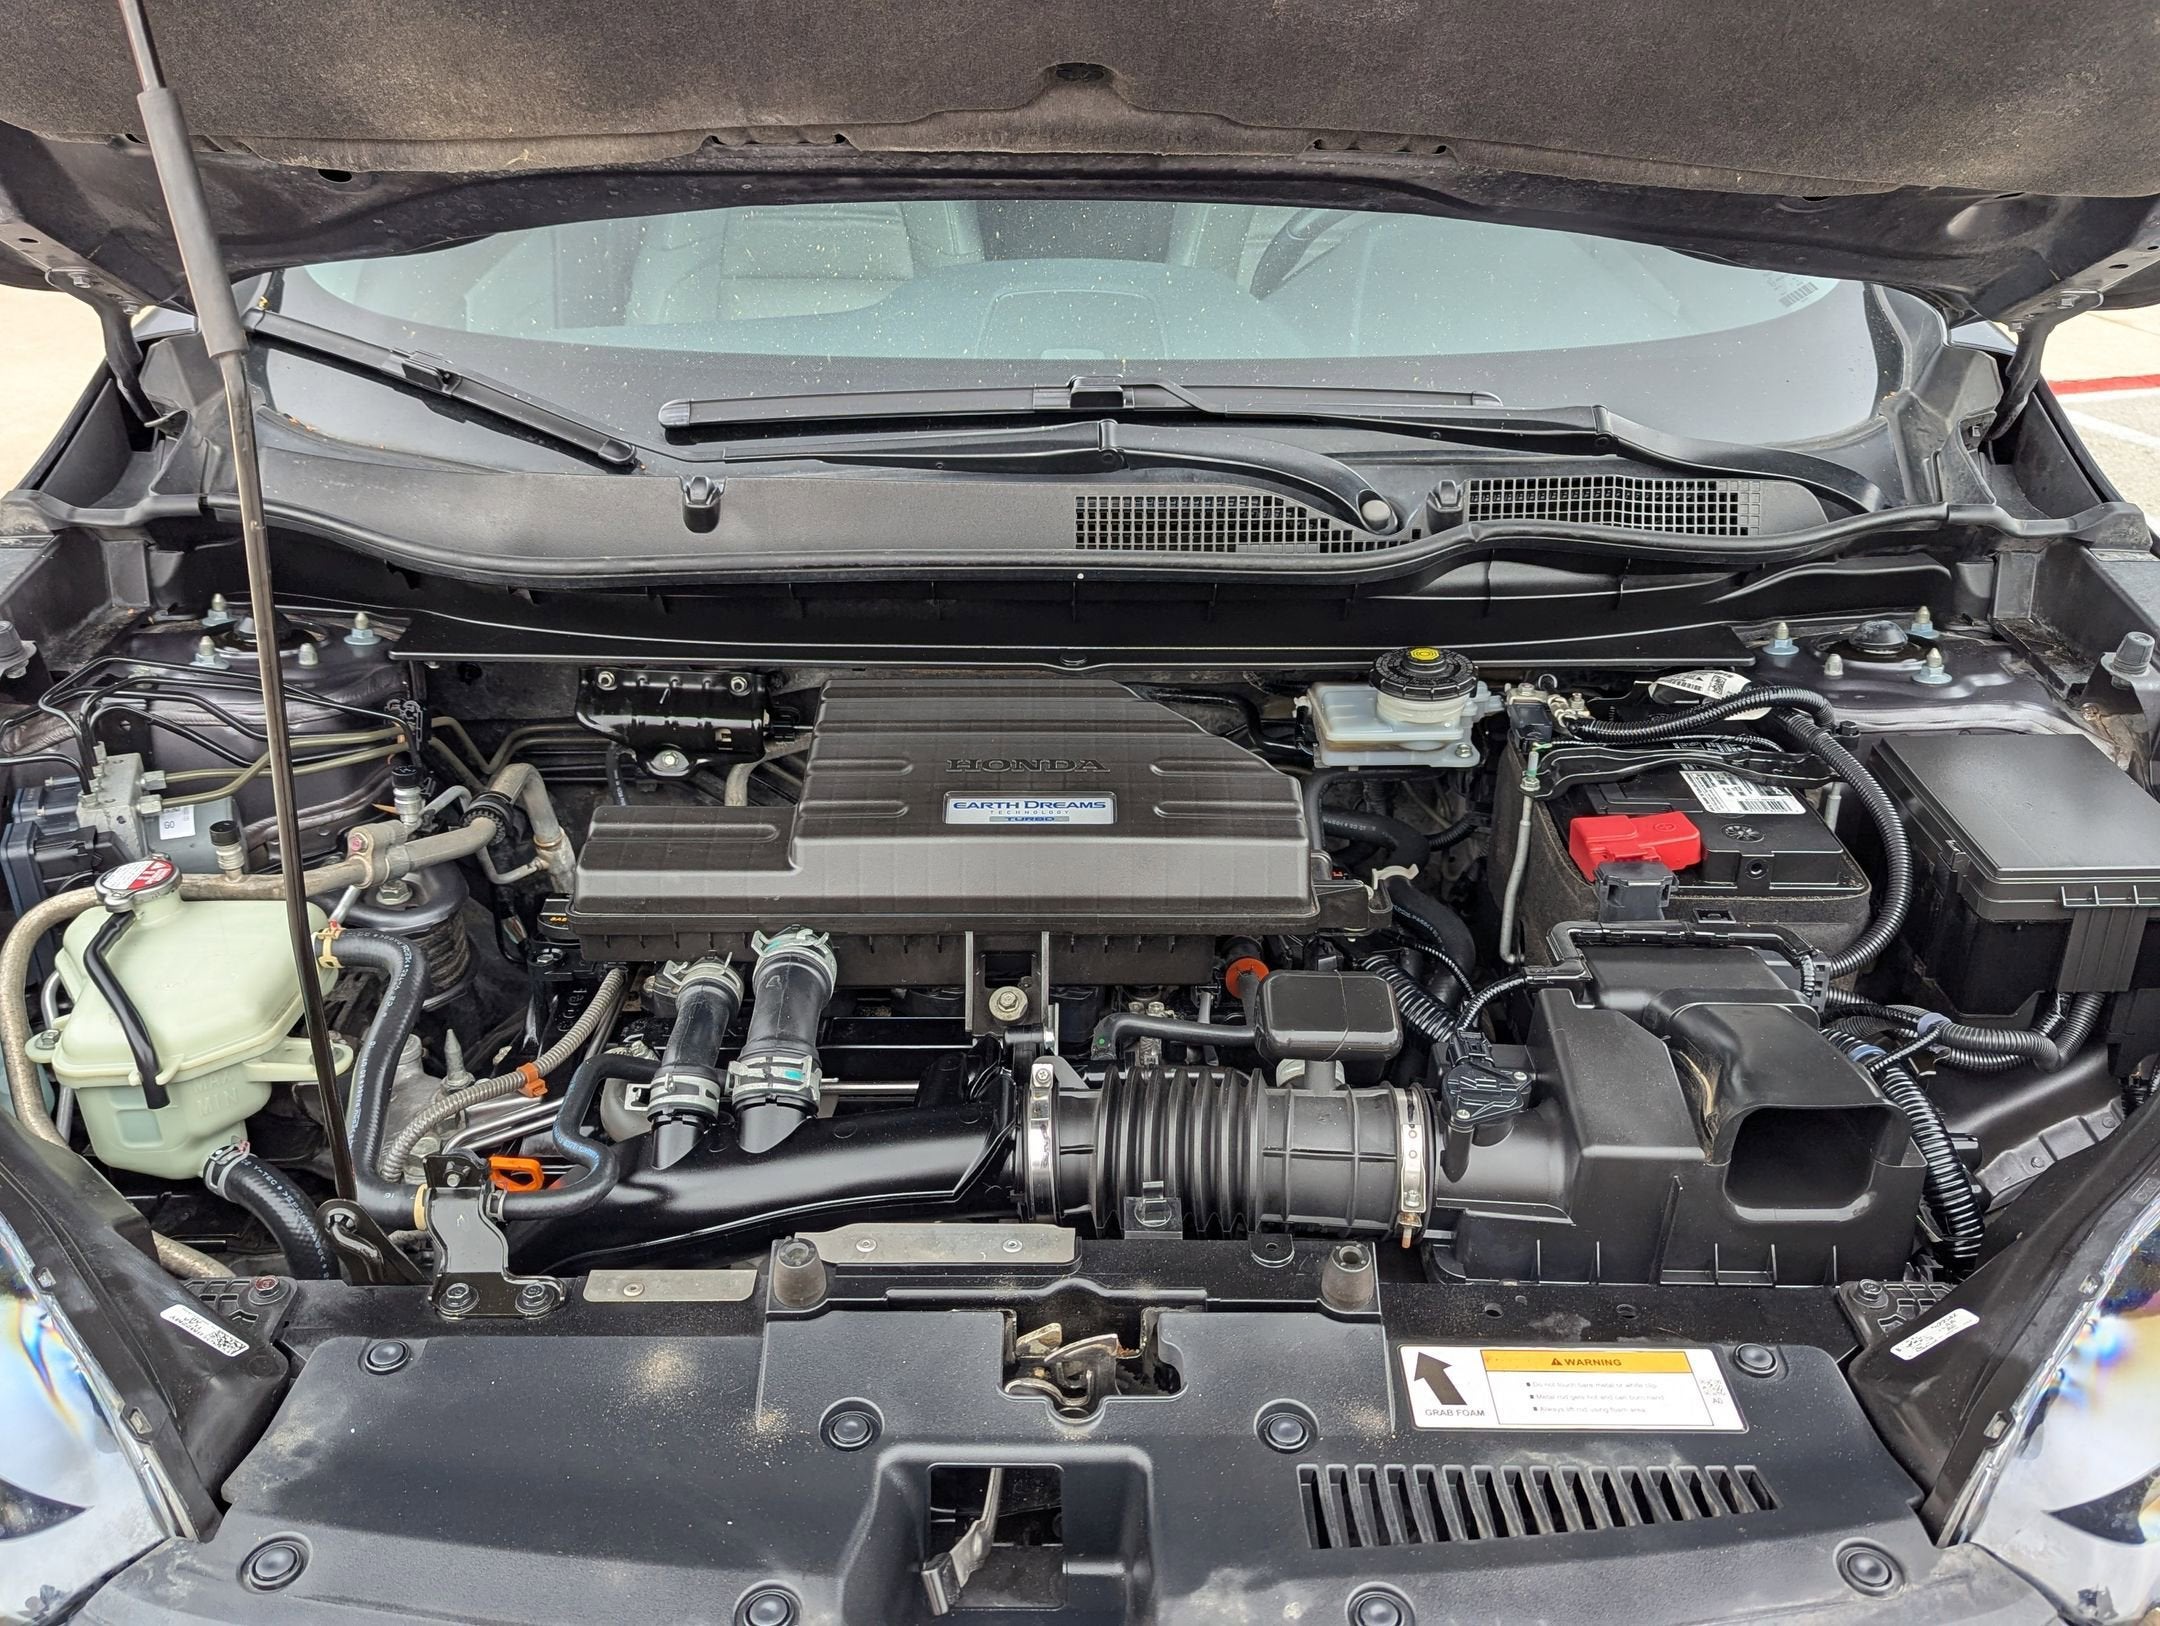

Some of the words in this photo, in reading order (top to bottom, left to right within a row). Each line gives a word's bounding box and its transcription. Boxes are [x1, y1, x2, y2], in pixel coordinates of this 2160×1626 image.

[945, 758, 1111, 773] HONDA
[953, 801, 1019, 809] EARTH
[1024, 800, 1107, 810] DREAMS
[196, 1087, 240, 1117] MIN
[1563, 1358, 1622, 1367] WARNING
[1424, 1408, 1454, 1417] GRAB
[1456, 1409, 1486, 1417] FOAM
